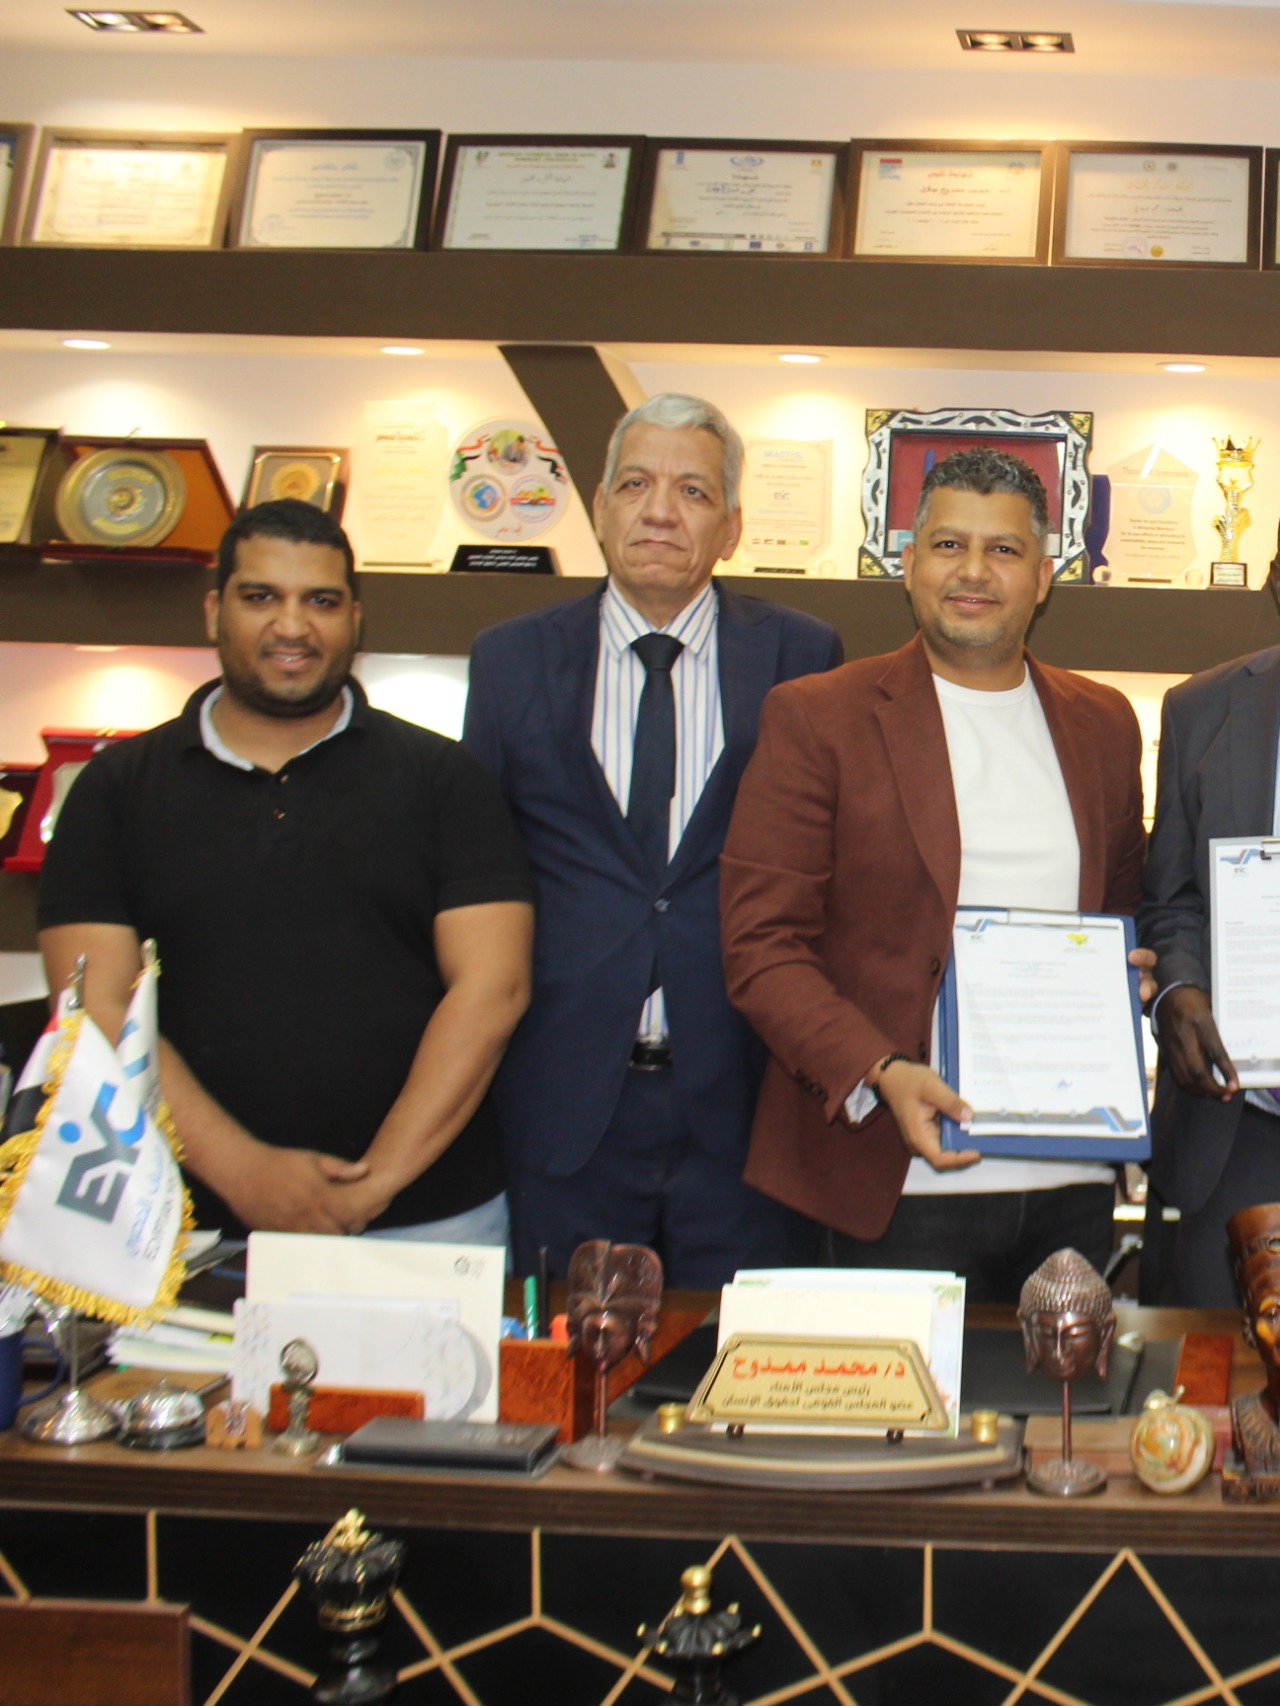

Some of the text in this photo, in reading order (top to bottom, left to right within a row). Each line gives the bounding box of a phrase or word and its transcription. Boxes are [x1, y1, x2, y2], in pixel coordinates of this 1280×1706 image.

[733, 1355, 807, 1380] ممدوح
[813, 1357, 878, 1377] محمد
[805, 1384, 839, 1395] مجلس
[843, 1385, 870, 1396] رئيس
[763, 1395, 800, 1408] لحقوق
[845, 1397, 886, 1410] المجلس
[889, 1398, 913, 1410] عضو
